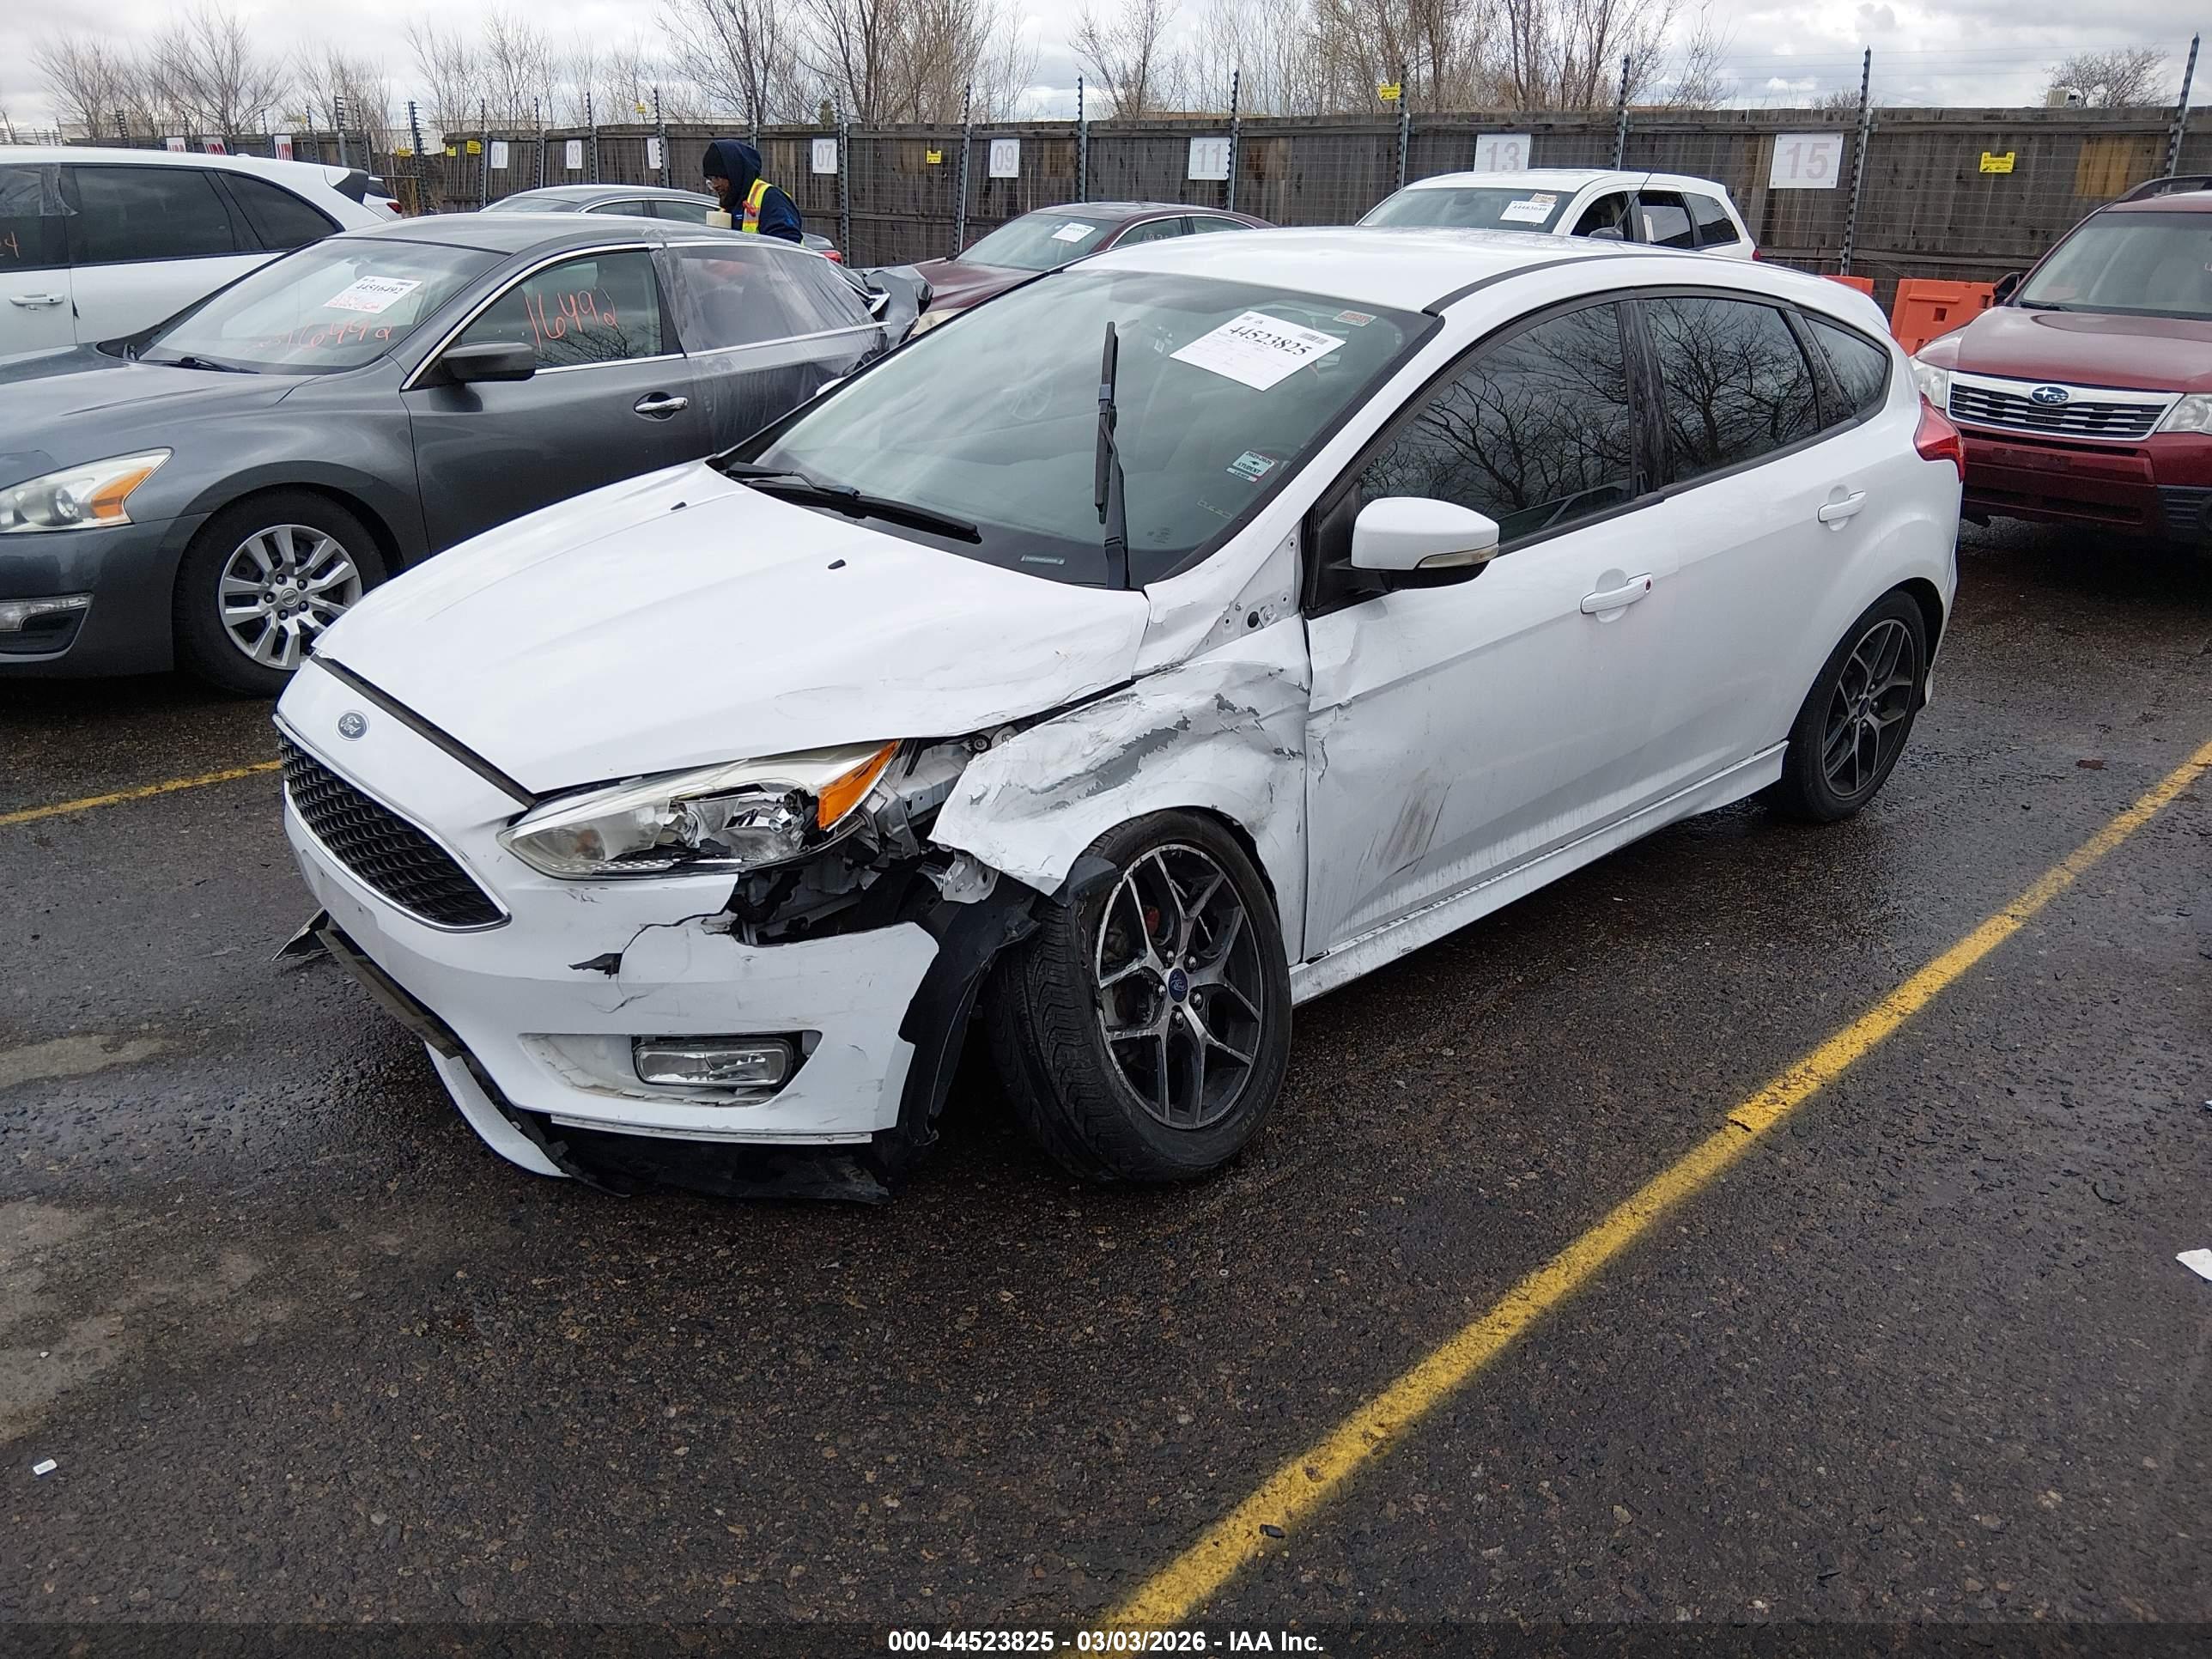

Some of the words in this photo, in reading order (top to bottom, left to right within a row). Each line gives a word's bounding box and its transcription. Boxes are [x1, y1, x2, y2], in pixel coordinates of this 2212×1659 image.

[492, 146, 506, 164] 01
[568, 146, 580, 165] 03
[816, 143, 834, 168] 07
[994, 144, 1014, 171] 09
[1197, 144, 1221, 172] 11
[1486, 142, 1520, 172] 13
[1785, 142, 1831, 179] 15
[524, 289, 619, 351] 16492
[1229, 325, 1313, 356] 44523825
